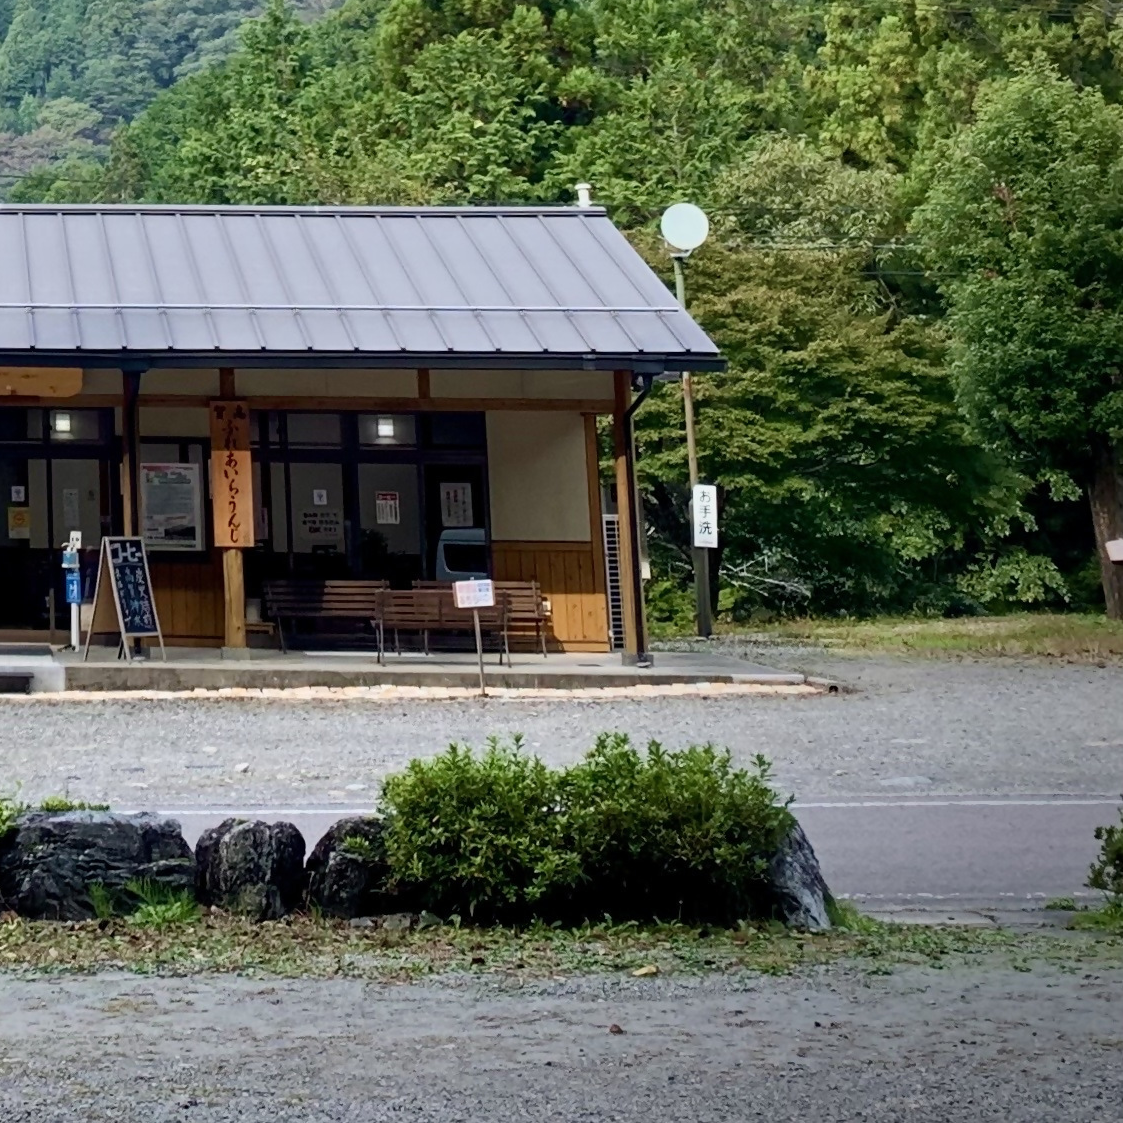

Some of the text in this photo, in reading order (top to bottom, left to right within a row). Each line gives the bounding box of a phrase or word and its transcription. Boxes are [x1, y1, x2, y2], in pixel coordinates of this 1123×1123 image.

[222, 419, 242, 544] ふれあいらうんじ
[699, 489, 713, 536] お手洗
[110, 541, 143, 564] コーヒー
